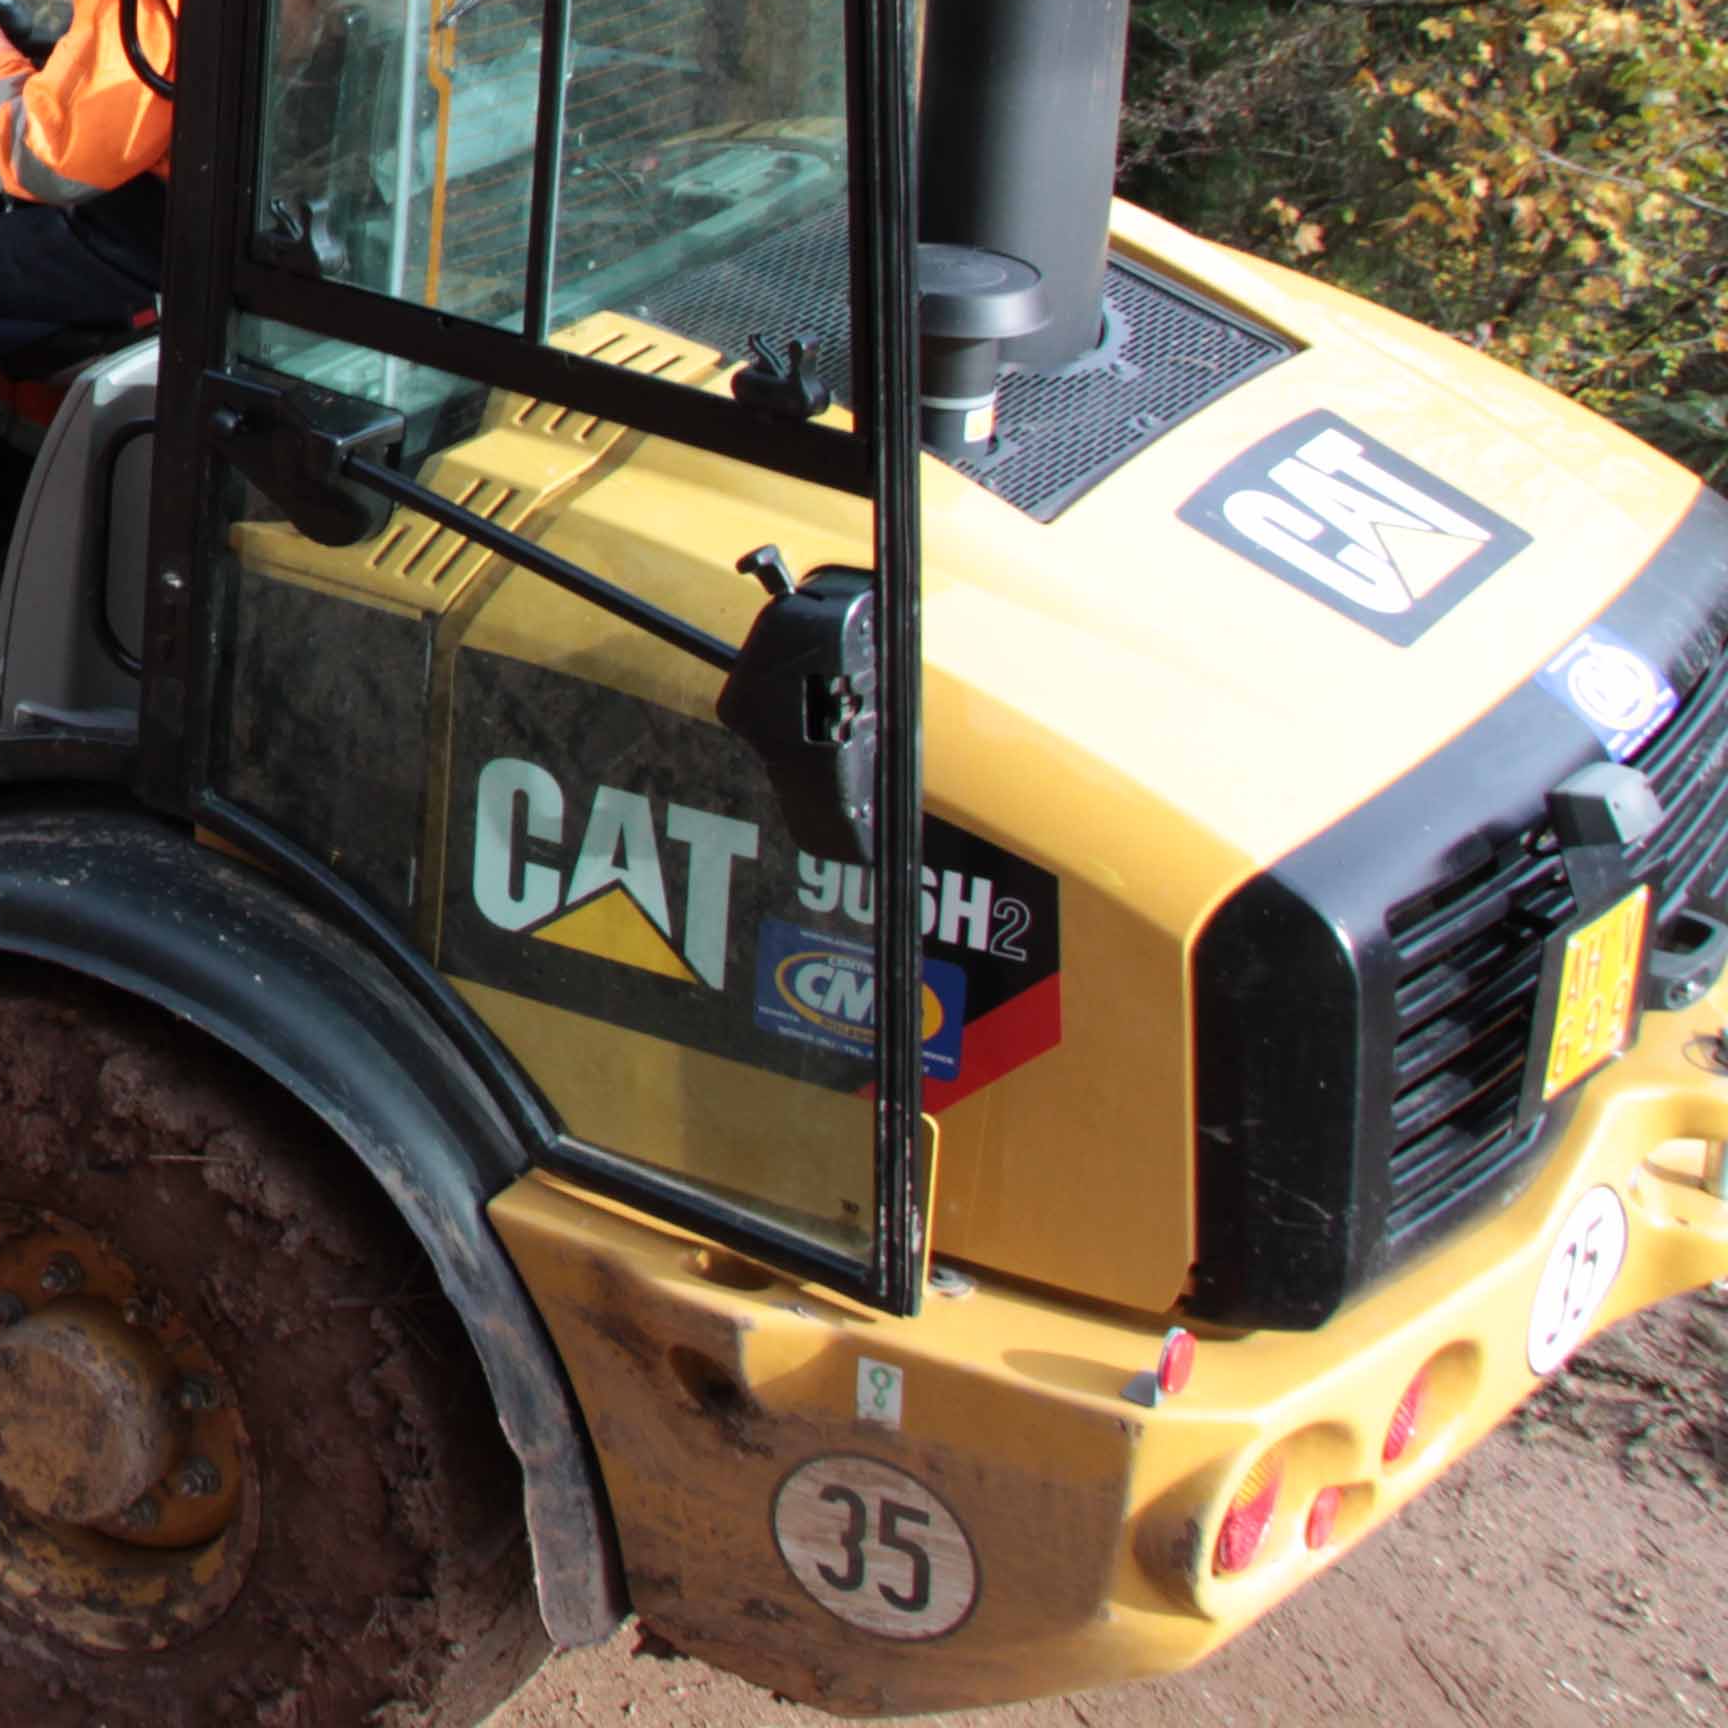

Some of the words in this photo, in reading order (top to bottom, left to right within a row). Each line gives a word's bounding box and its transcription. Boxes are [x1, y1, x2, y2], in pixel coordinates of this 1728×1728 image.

[1222, 427, 1494, 614] CAT
[473, 757, 759, 991] CAT
[1544, 1212, 1604, 1346] 35
[815, 1484, 931, 1613] 35
